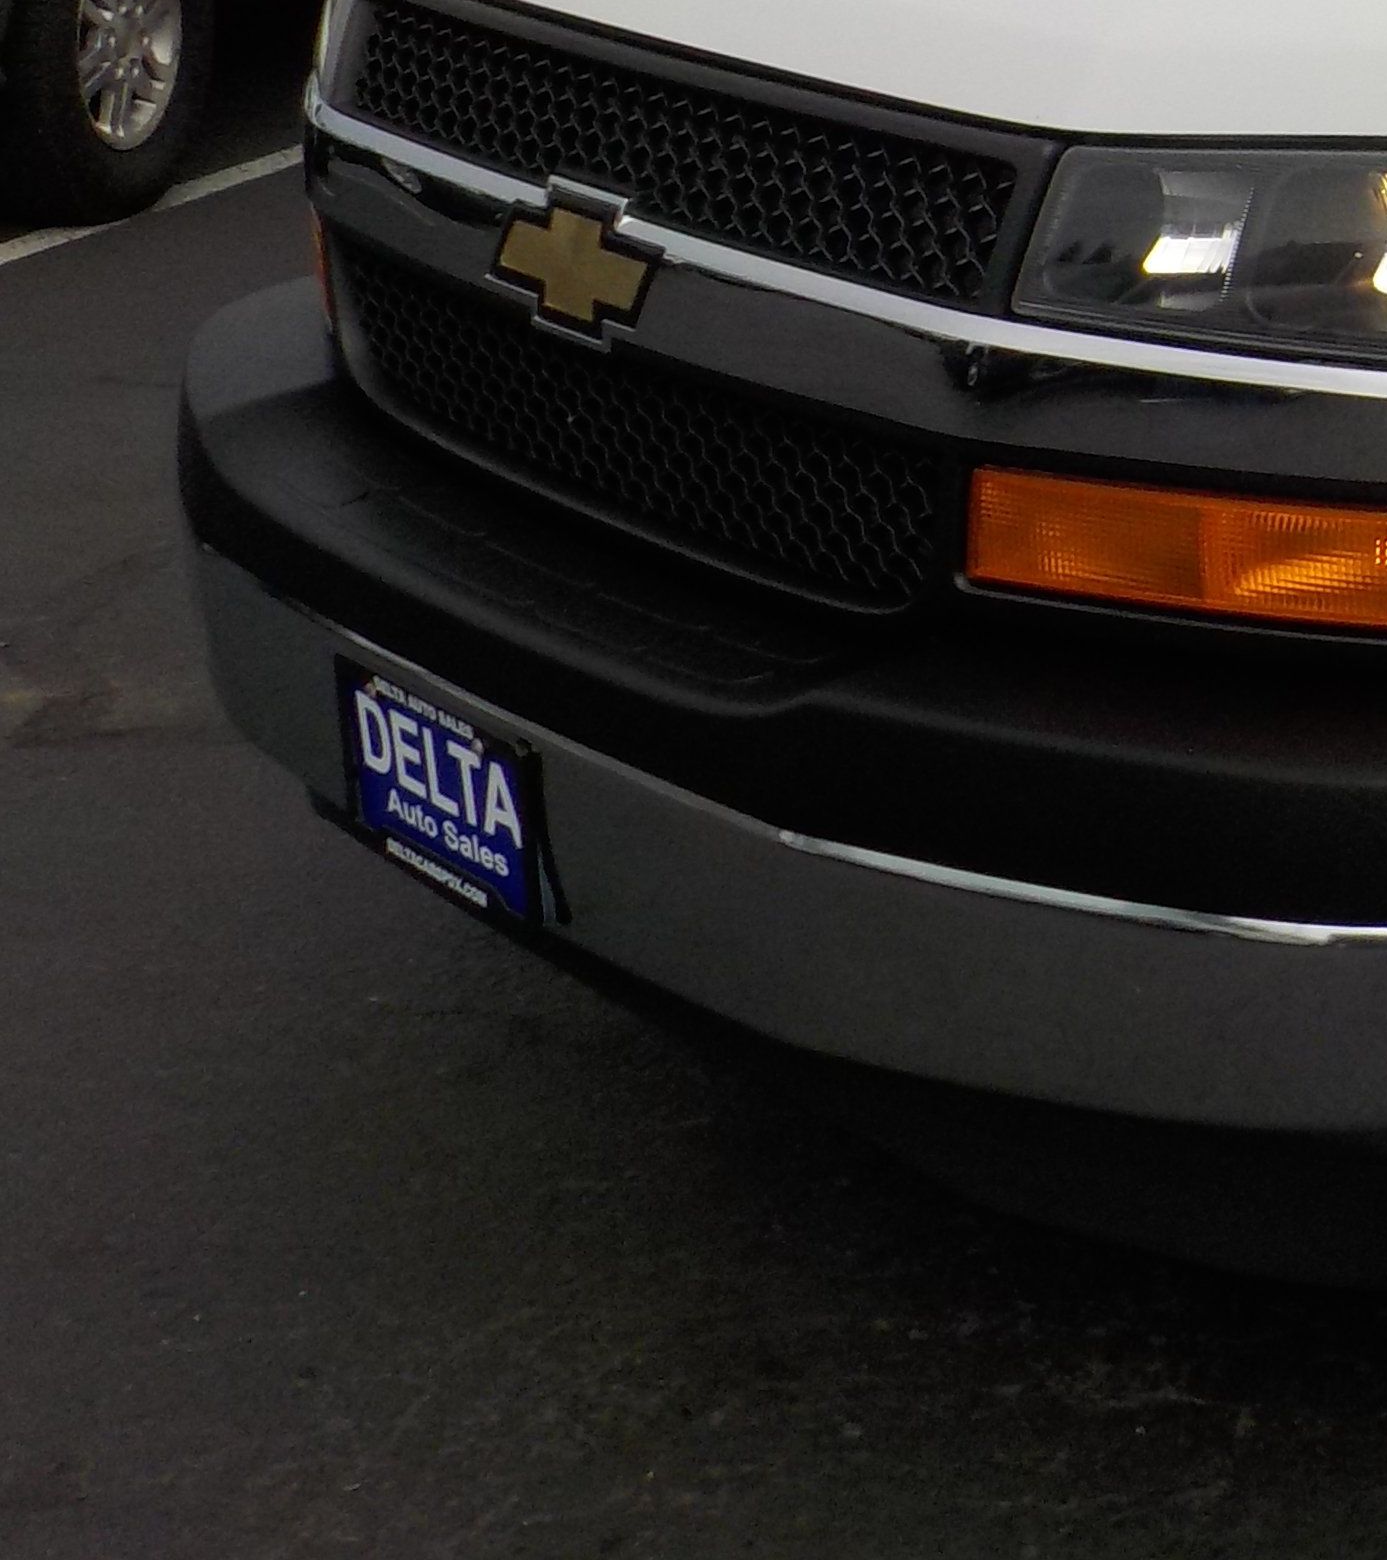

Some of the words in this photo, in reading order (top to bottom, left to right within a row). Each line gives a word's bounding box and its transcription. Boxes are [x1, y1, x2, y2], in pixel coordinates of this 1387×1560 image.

[355, 690, 522, 849] DELTA
[387, 788, 438, 838] Auto
[442, 820, 509, 877] Sales
